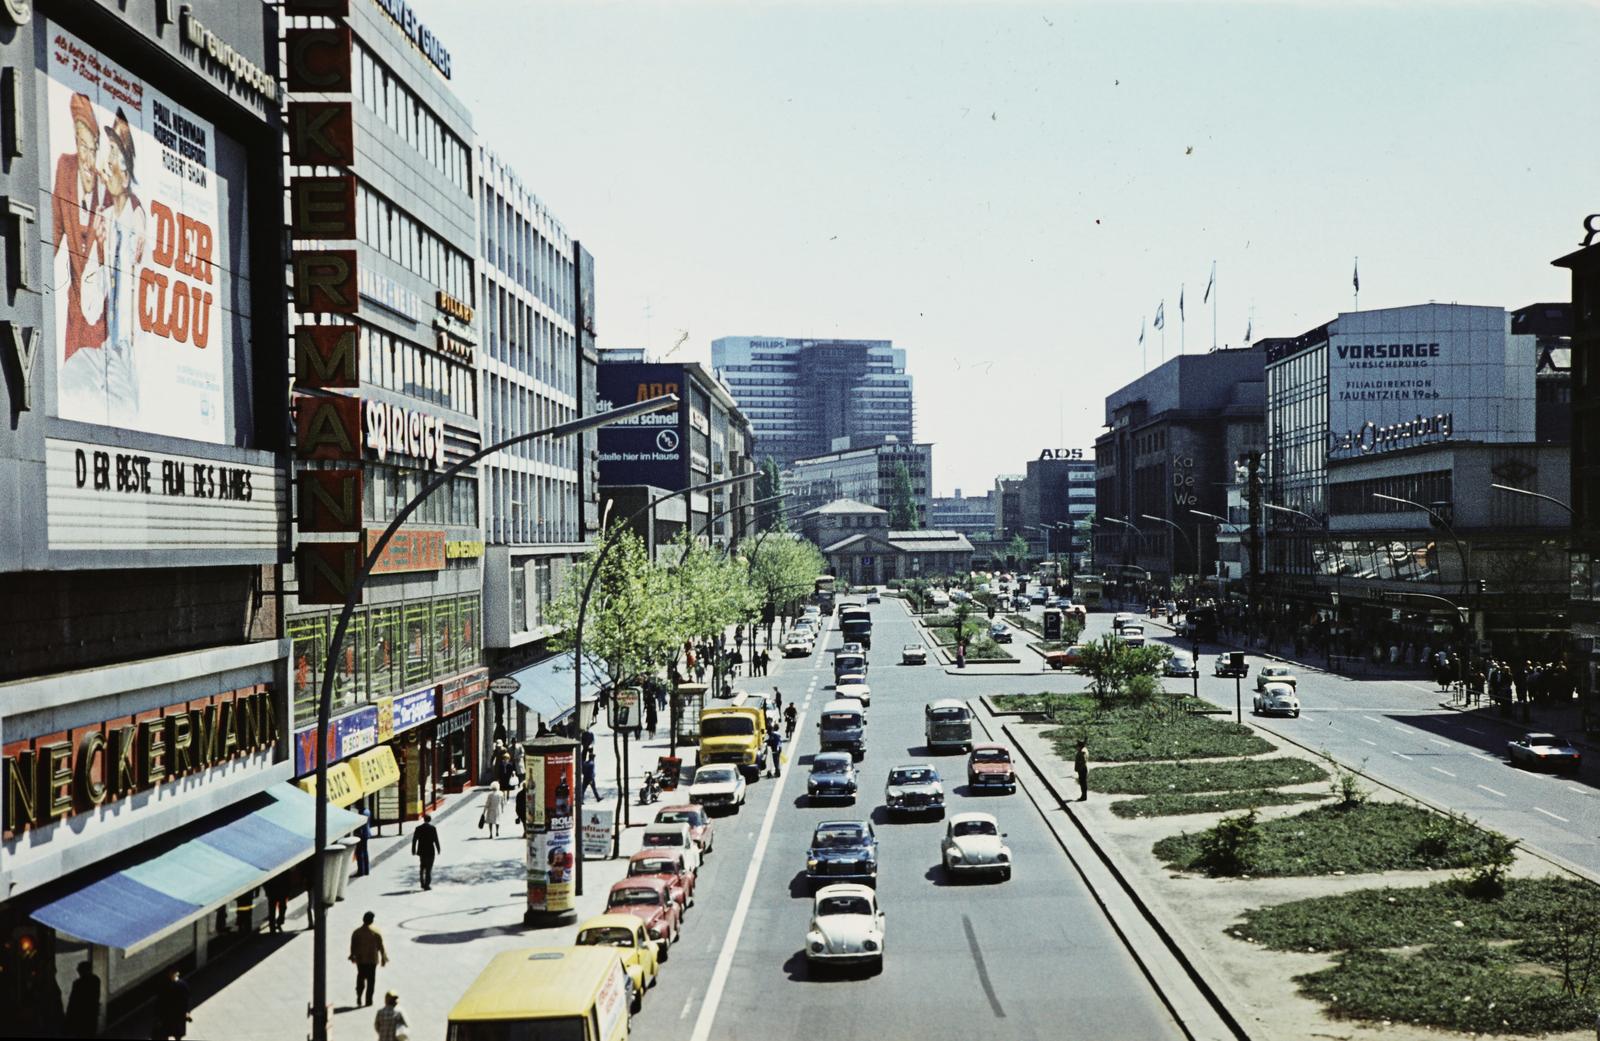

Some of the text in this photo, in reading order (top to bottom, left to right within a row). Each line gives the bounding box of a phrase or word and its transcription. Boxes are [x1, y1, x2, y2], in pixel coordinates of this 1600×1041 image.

[153, 99, 206, 150] PAUL NEWMAN
[151, 200, 213, 285] DER
[294, 0, 358, 598] CKERMANN
[138, 267, 213, 349] CLOU
[750, 340, 784, 349] PHILIPS
[1336, 343, 1440, 359] VORSORGE
[1349, 360, 1428, 369] VERSICHERUNG
[1346, 380, 1432, 389] FILIALDIREKTION
[1339, 391, 1410, 400] TAUENTZIEN
[641, 412, 679, 425] schnell
[623, 452, 638, 460] hier
[640, 452, 650, 460] im
[652, 452, 679, 461] Hause
[1039, 448, 1083, 460] ADS
[1173, 455, 1193, 468] Ka
[116, 453, 151, 495] BESTE
[161, 458, 186, 497] FILM
[193, 463, 215, 499] DES
[218, 467, 253, 502] JAHRES
[1173, 473, 1194, 487] De
[1174, 491, 1198, 505] We
[1047, 614, 1057, 628] P
[2, 691, 280, 832] NECKERMANN
